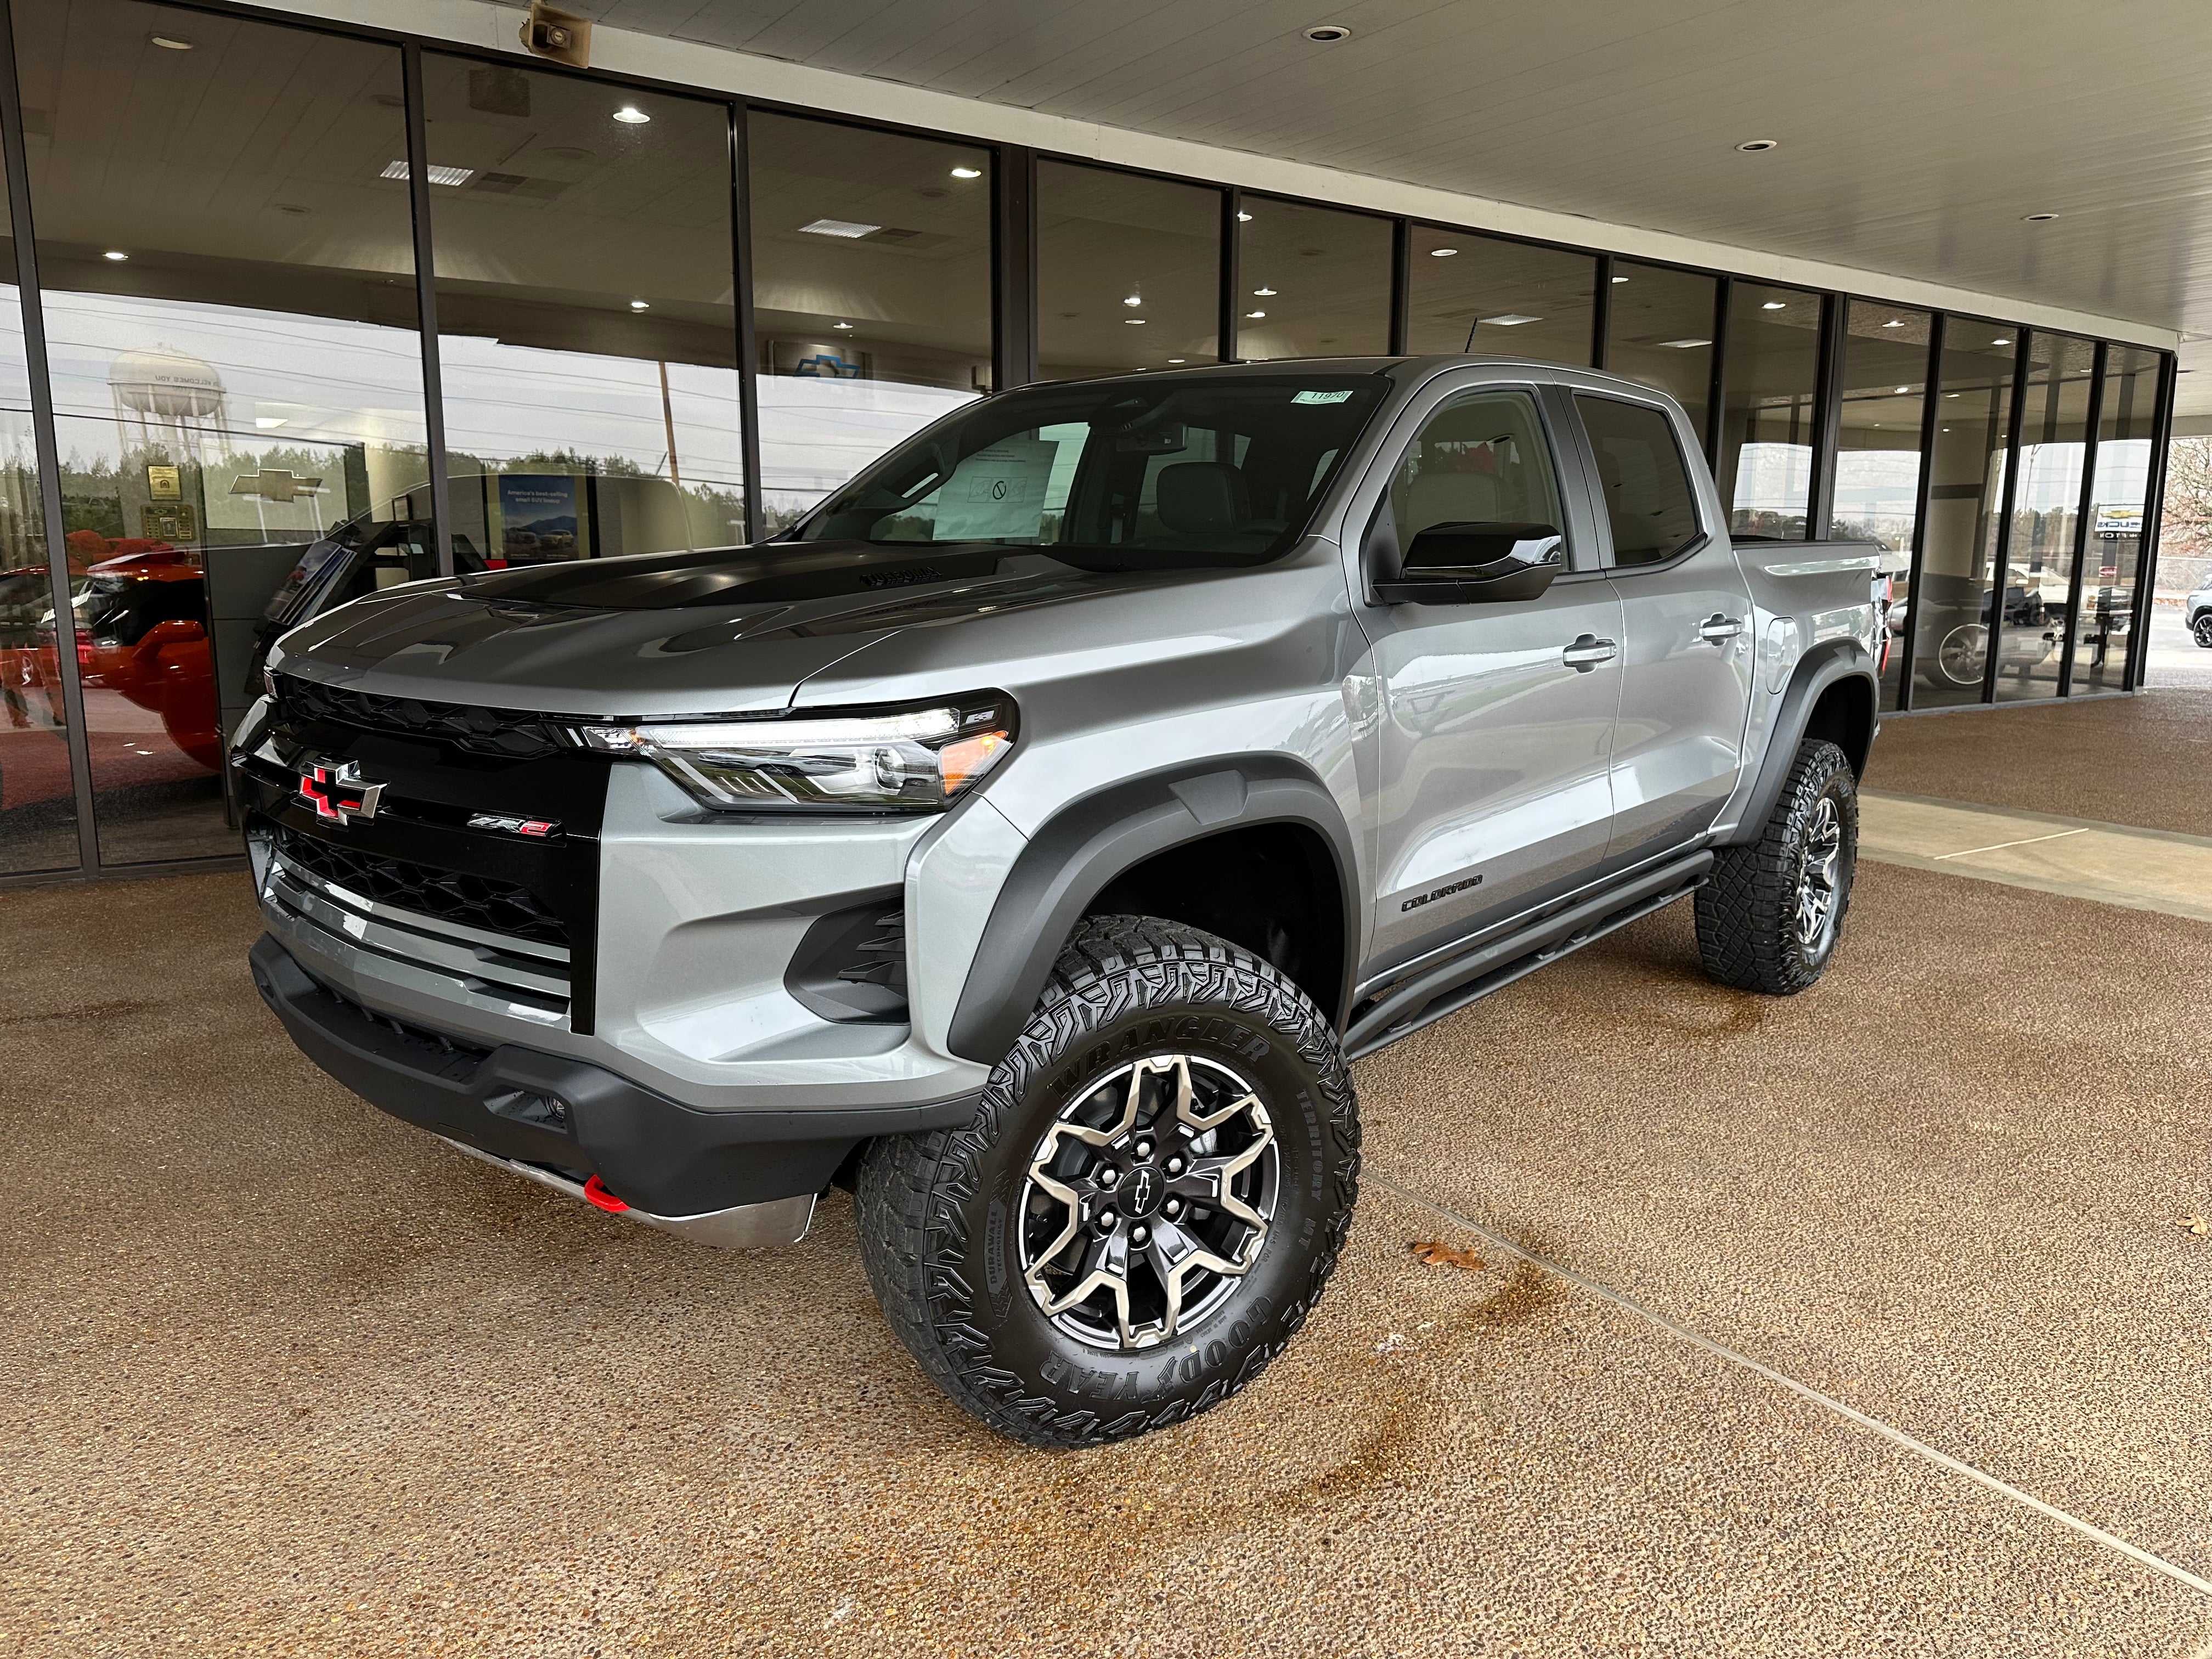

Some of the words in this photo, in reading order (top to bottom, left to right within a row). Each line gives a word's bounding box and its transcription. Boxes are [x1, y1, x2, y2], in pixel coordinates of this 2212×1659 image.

[1311, 392, 1345, 400] 11970
[466, 812, 553, 838] ZR2
[1401, 874, 1483, 912] COLORADO
[1047, 1015, 1273, 1099] WRANGLER
[1296, 1088, 1324, 1202] TERRITORY
[988, 1210, 997, 1284] DURAWALL
[1298, 1217, 1317, 1251] MT
[1039, 1295, 1273, 1404] GOODYEAR
